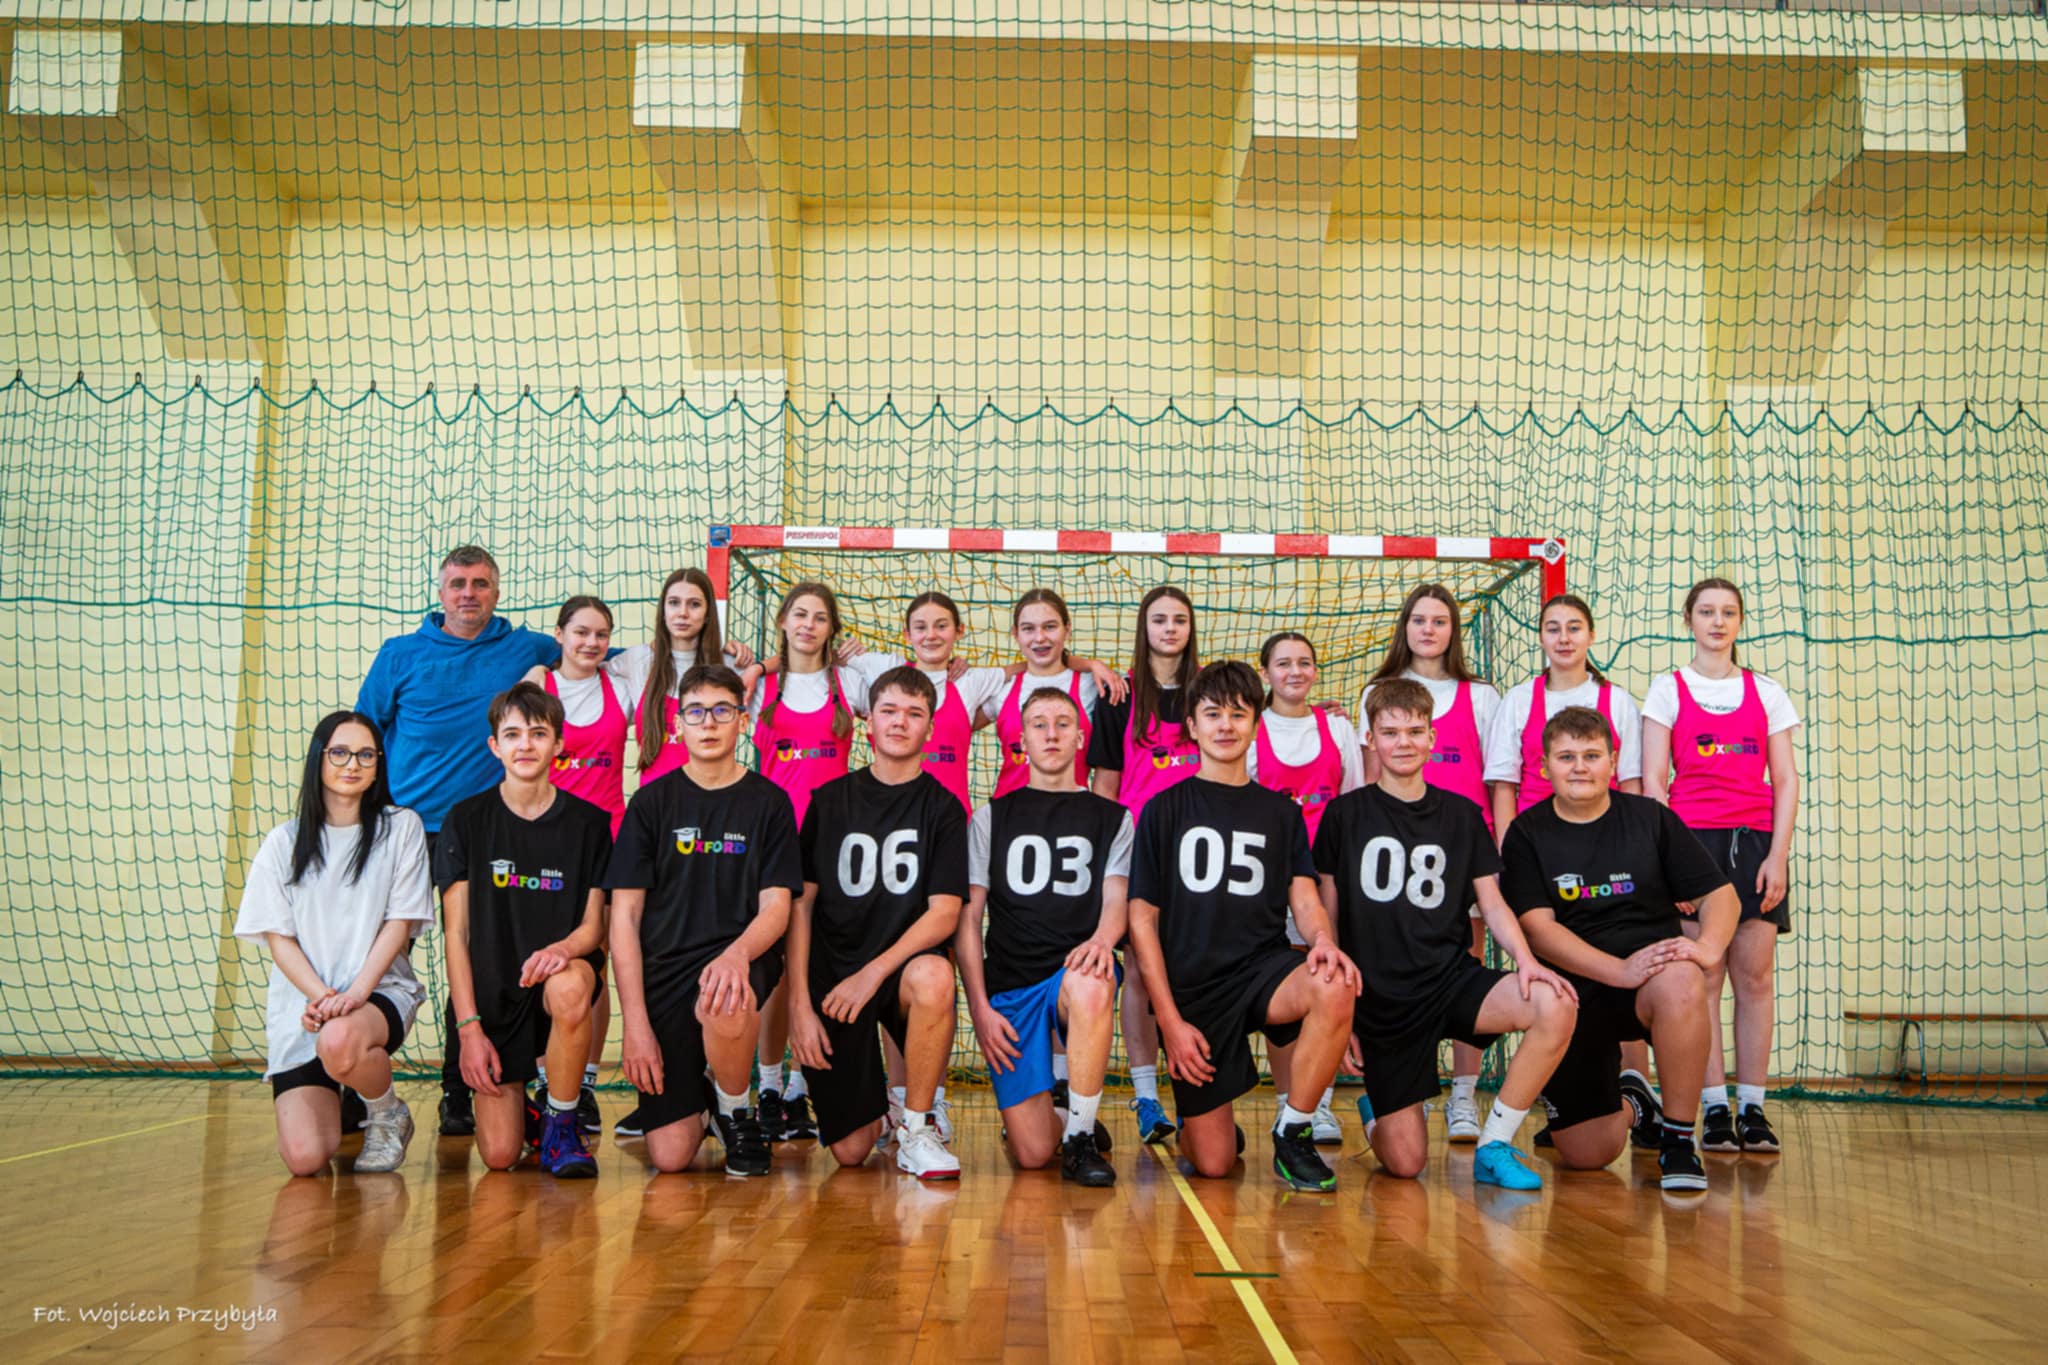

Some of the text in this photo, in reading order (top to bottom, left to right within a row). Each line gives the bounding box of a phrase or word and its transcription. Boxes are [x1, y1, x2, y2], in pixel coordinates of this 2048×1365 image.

[837, 828, 920, 898] 06
[1006, 834, 1094, 897] 03
[1178, 826, 1267, 896] 05
[1360, 835, 1447, 909] 08
